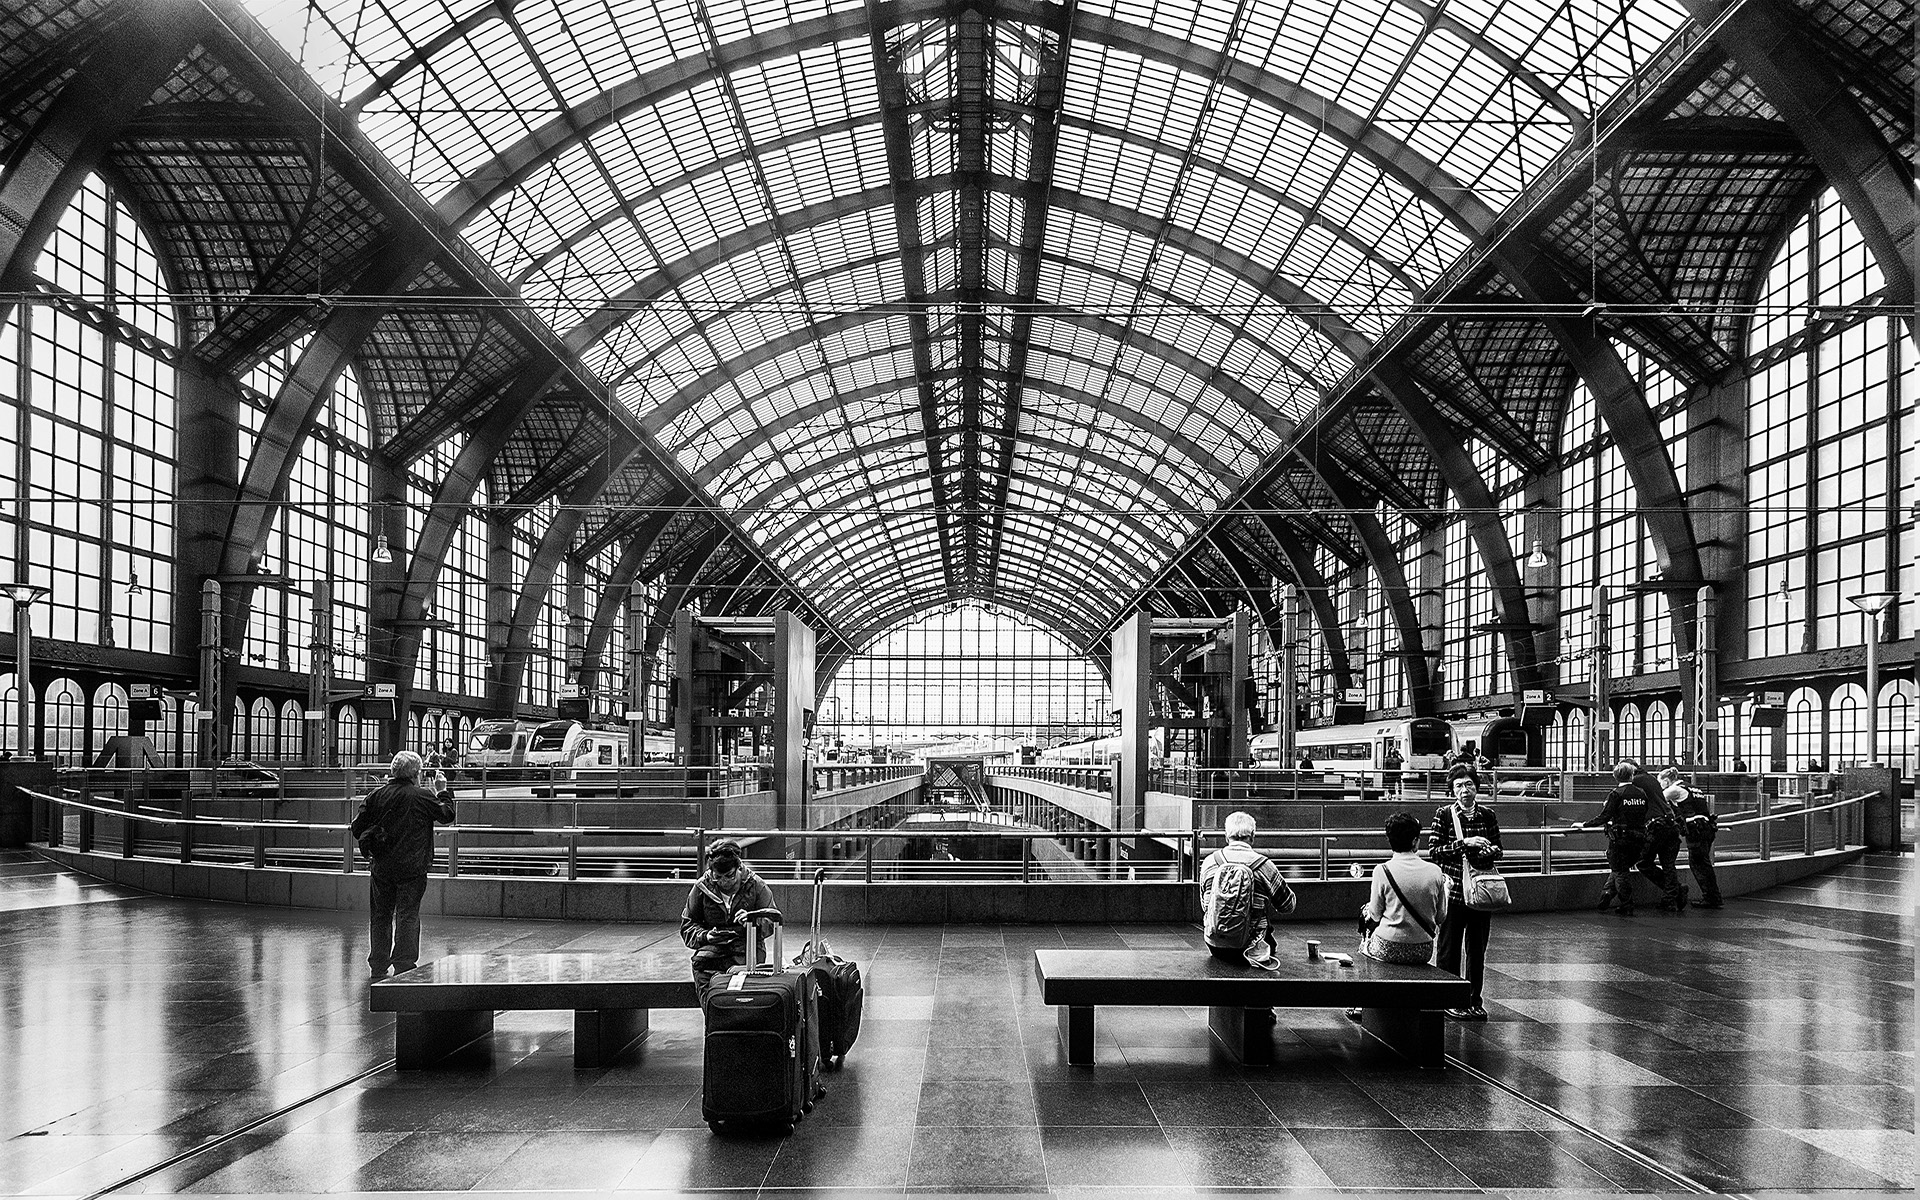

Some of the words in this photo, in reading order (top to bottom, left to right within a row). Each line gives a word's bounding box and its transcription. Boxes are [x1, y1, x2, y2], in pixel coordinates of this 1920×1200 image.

[153, 687, 159, 695] 6
[367, 687, 373, 695] 5
[581, 687, 587, 695] 4
[1337, 692, 1343, 700] 3
[1546, 693, 1552, 701] 2
[1623, 798, 1646, 806] Politie
